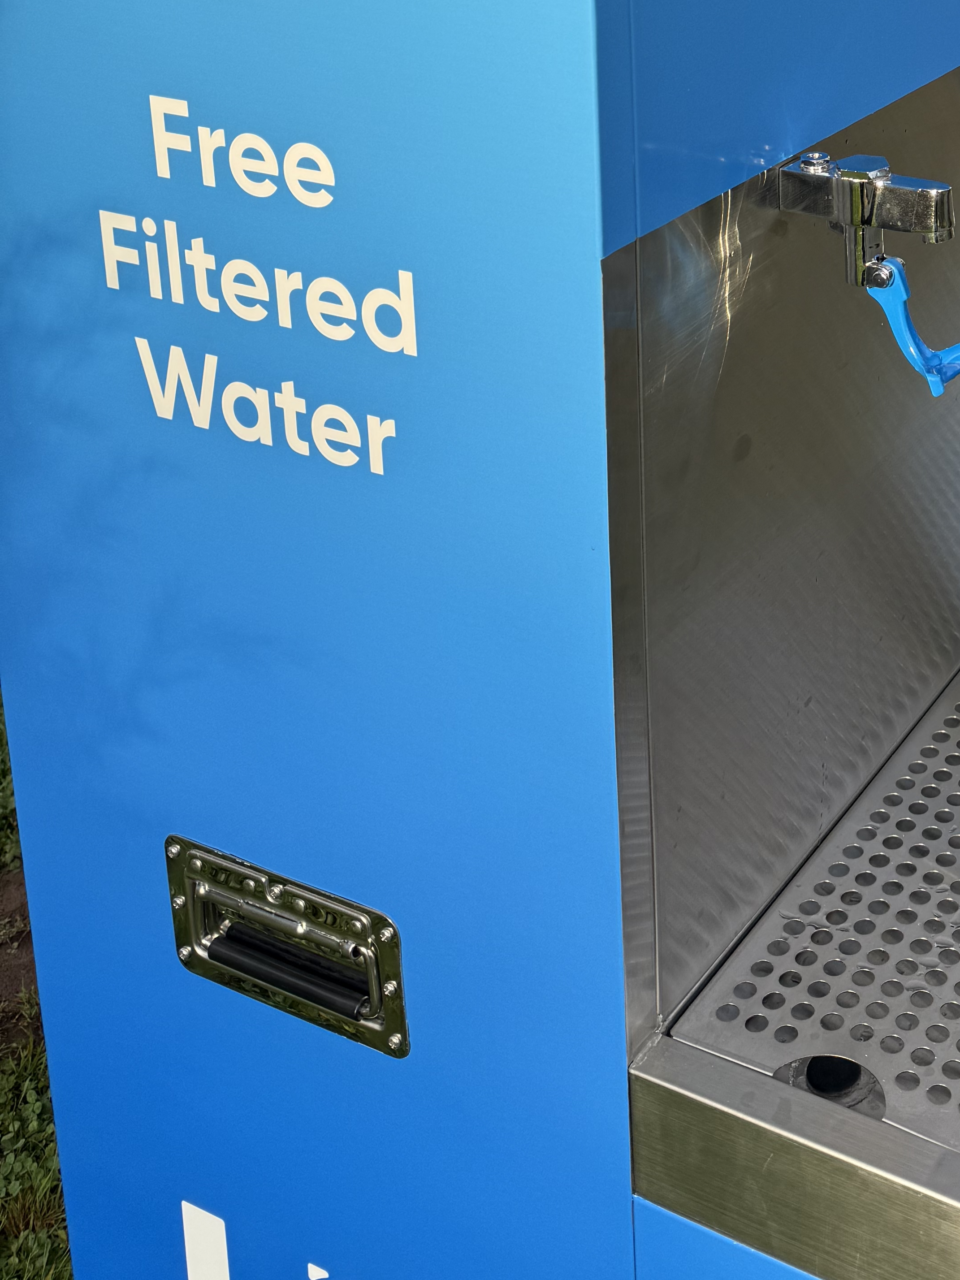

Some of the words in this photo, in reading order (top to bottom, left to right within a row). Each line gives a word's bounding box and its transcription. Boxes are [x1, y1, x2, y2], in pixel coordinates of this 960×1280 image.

[149, 94, 336, 209] Free
[99, 209, 418, 357] Filtered
[134, 336, 396, 476] Water
